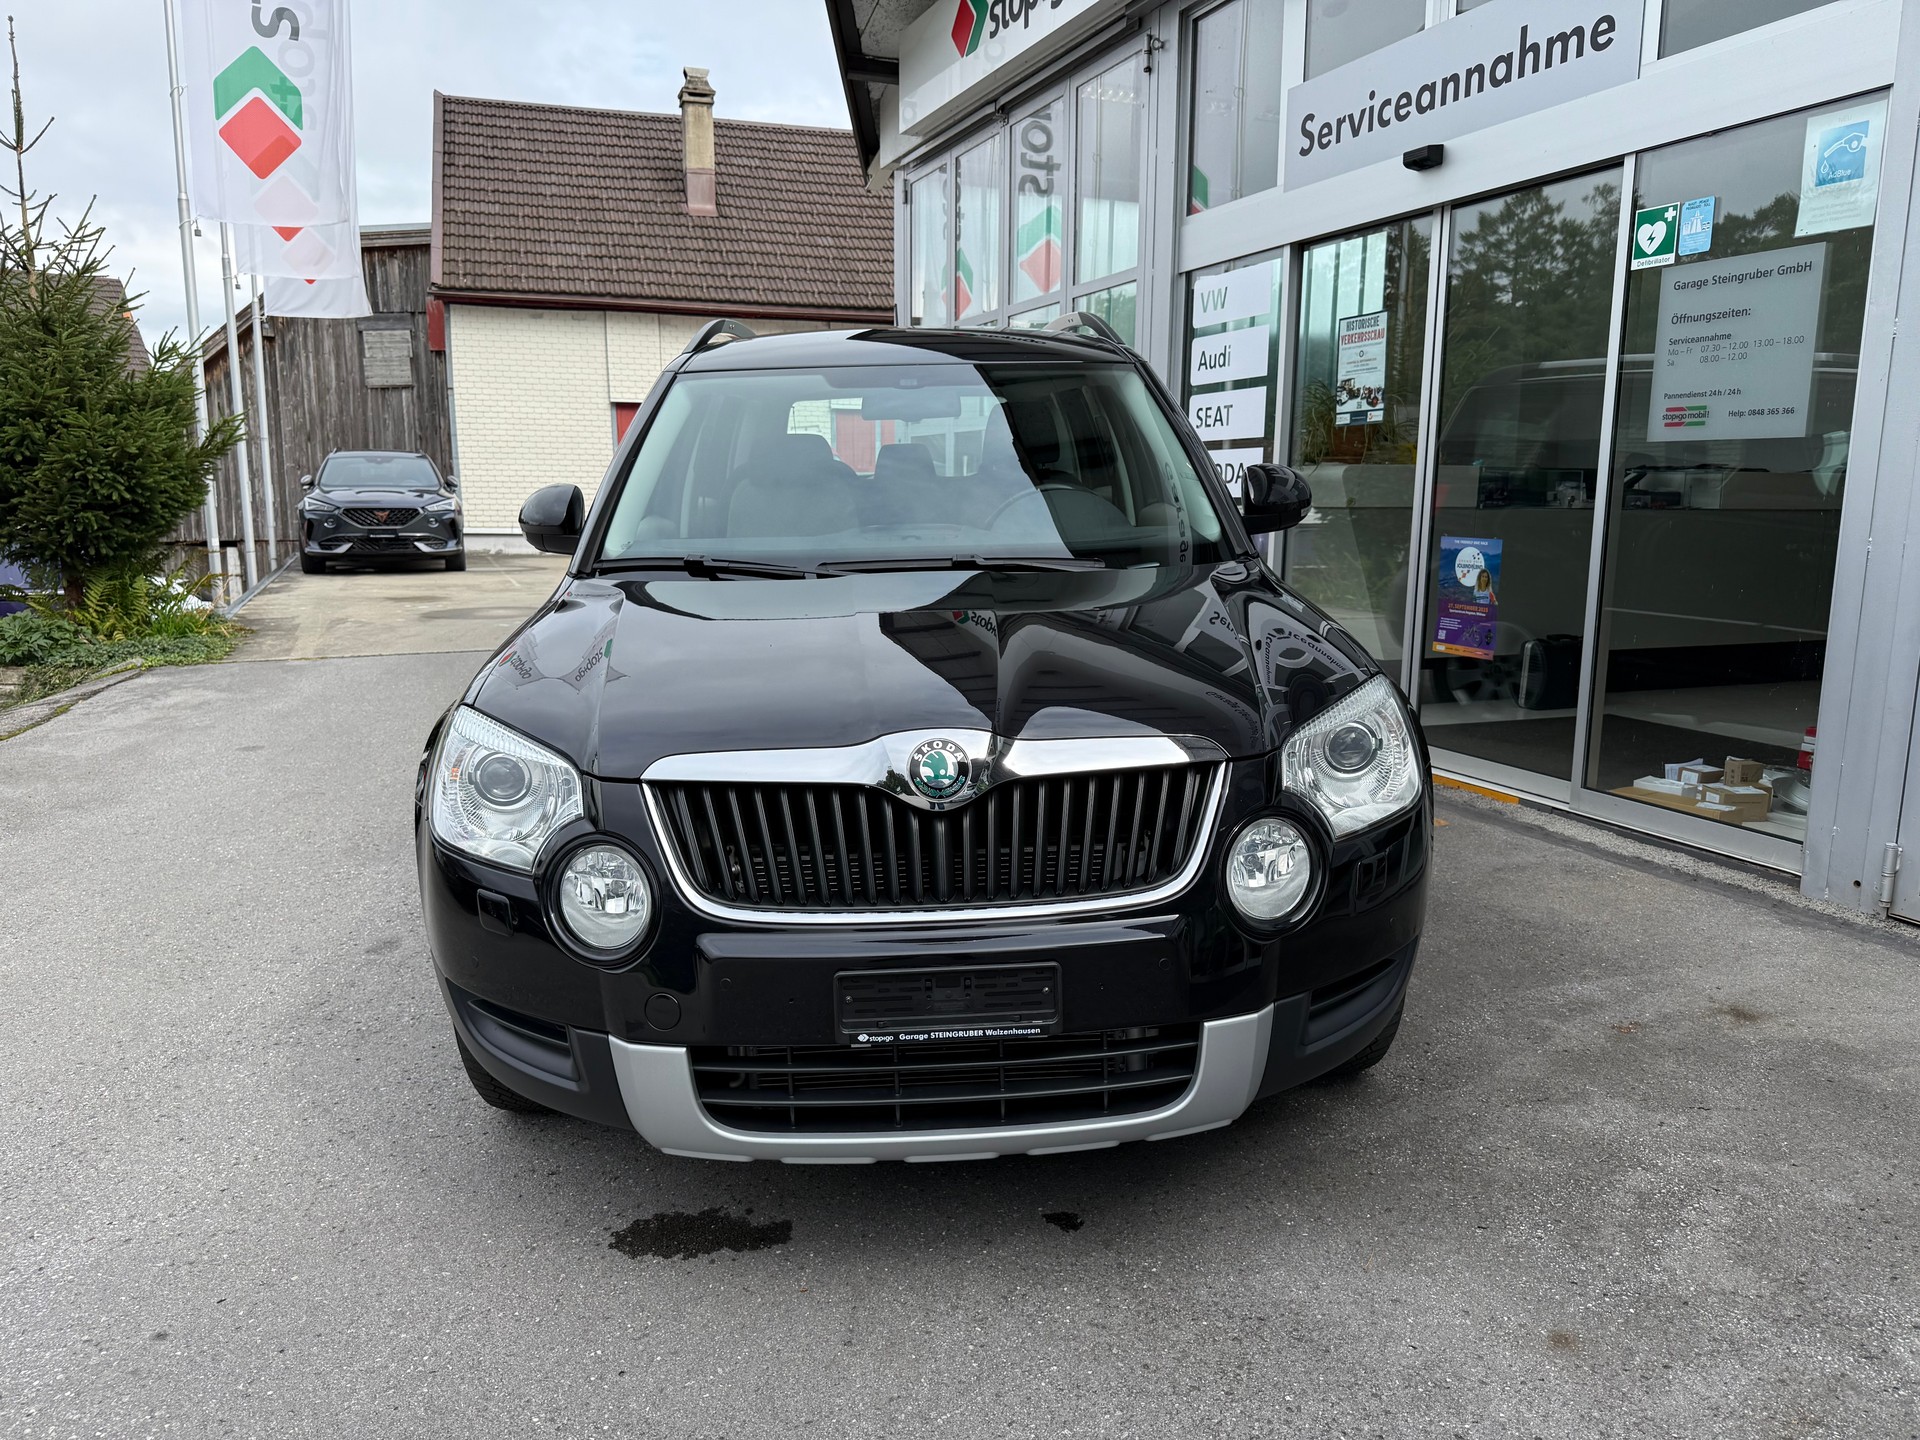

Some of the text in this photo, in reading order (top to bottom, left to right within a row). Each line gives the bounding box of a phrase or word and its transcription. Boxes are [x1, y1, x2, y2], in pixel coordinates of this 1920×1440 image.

[1299, 14, 1616, 157] Serviceannahme
[1828, 169, 1852, 179] AdBlue
[1636, 257, 1671, 268] Defibrillator
[1673, 260, 1813, 291] Garage Steingruber GmbH
[1200, 286, 1228, 313] VW
[1345, 315, 1380, 333] HISTORISCHE
[1671, 307, 1752, 325] Öffnungszeiten:
[1340, 327, 1386, 346] VERKEHRSSCHAU
[1667, 348, 1679, 356] Mo
[1700, 344, 1721, 353] 07.30
[1729, 341, 1749, 350] 12.00
[1753, 338, 1775, 348] 13.00
[1783, 335, 1805, 345] 18.00
[1668, 332, 1732, 346] Serviceannahme
[1197, 345, 1232, 372] Audi
[1667, 359, 1675, 367] Sa
[1699, 354, 1720, 364] 08.00
[1727, 352, 1748, 361] 12.00
[1663, 390, 1708, 400] Pannendienst
[1195, 404, 1234, 429] SEAT
[1728, 407, 1795, 418] Help: 0848 365 366
[899, 1033, 929, 1041] Garage
[930, 1029, 984, 1039] STEINGRUBER
[985, 1028, 1041, 1036] Walzenhausen
